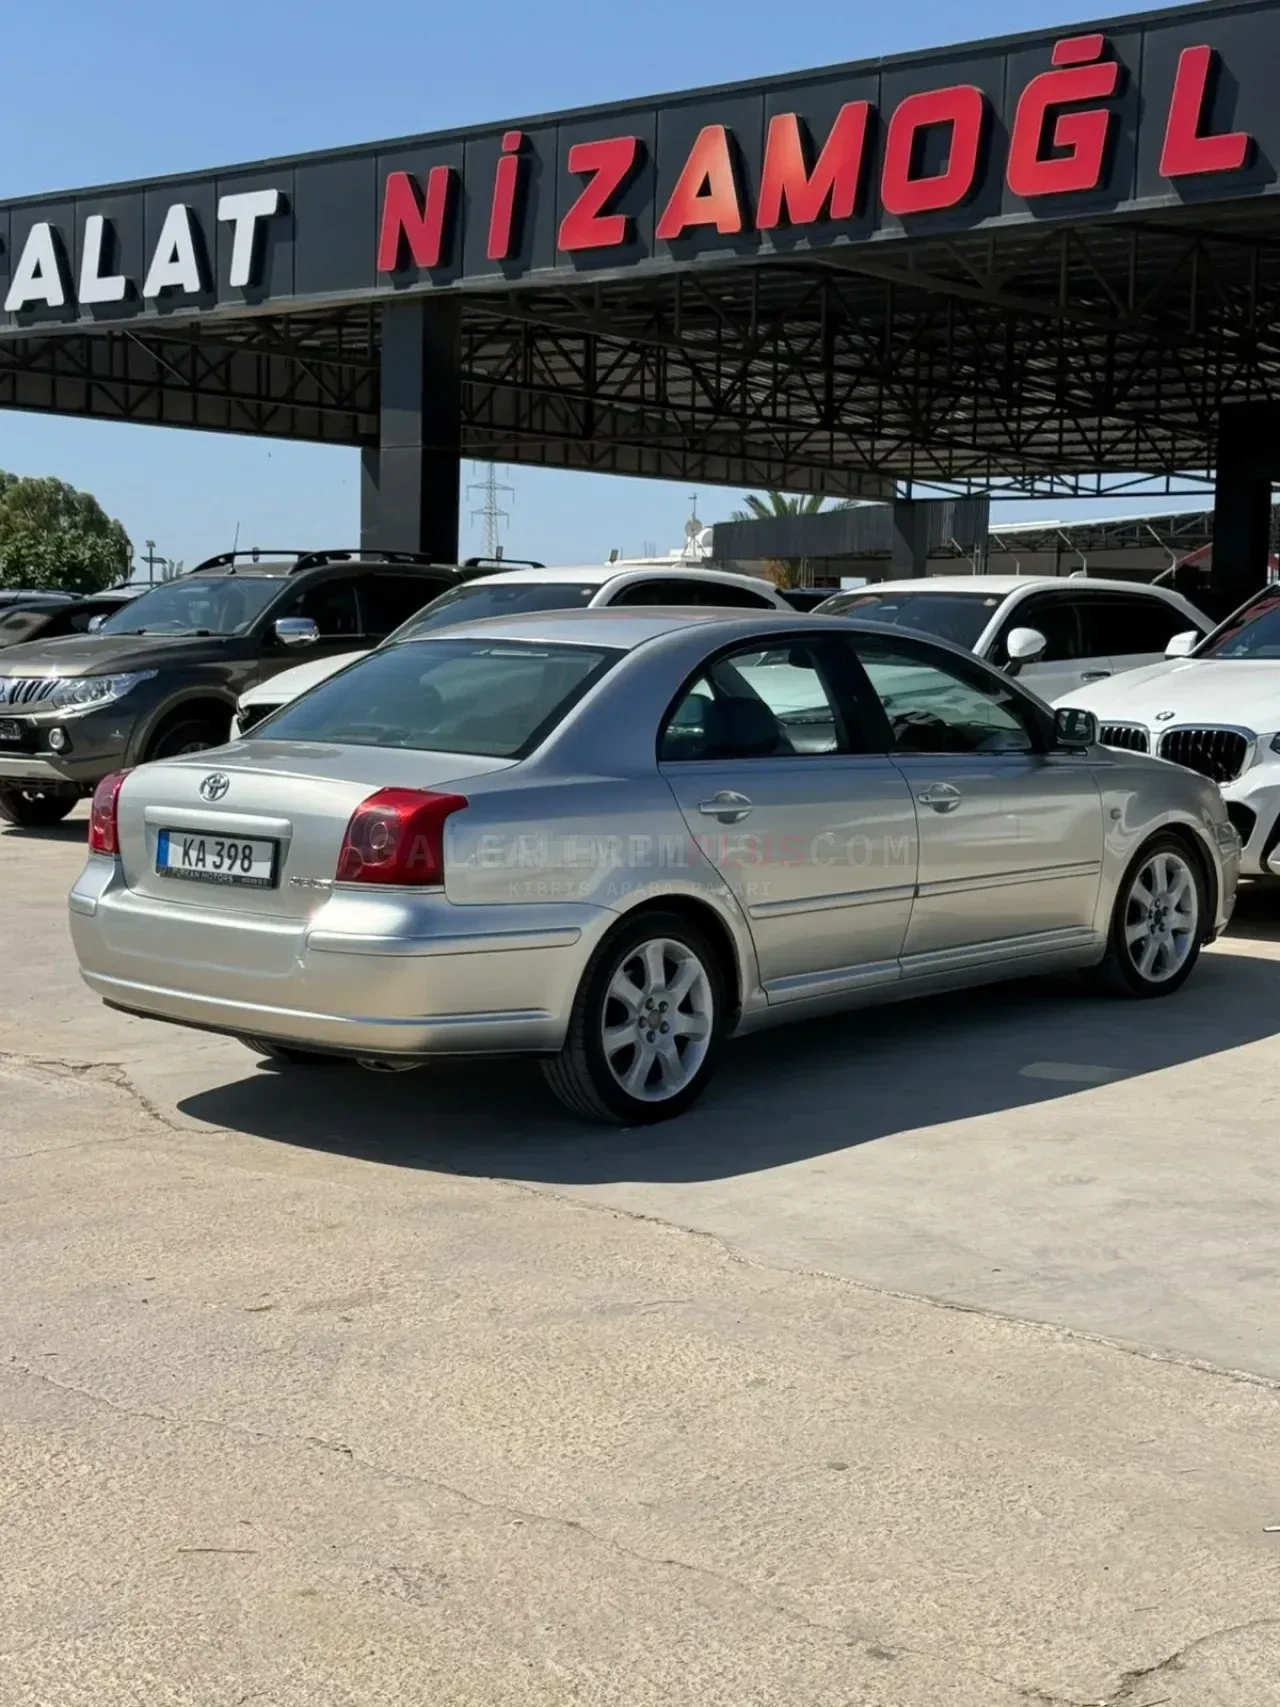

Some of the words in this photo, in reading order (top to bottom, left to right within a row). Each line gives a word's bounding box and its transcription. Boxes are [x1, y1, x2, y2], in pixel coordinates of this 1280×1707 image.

[4, 189, 279, 311] ALAT
[377, 32, 1249, 271] NİZAMOĞL
[182, 838, 206, 869] KA
[212, 841, 253, 873] 398
